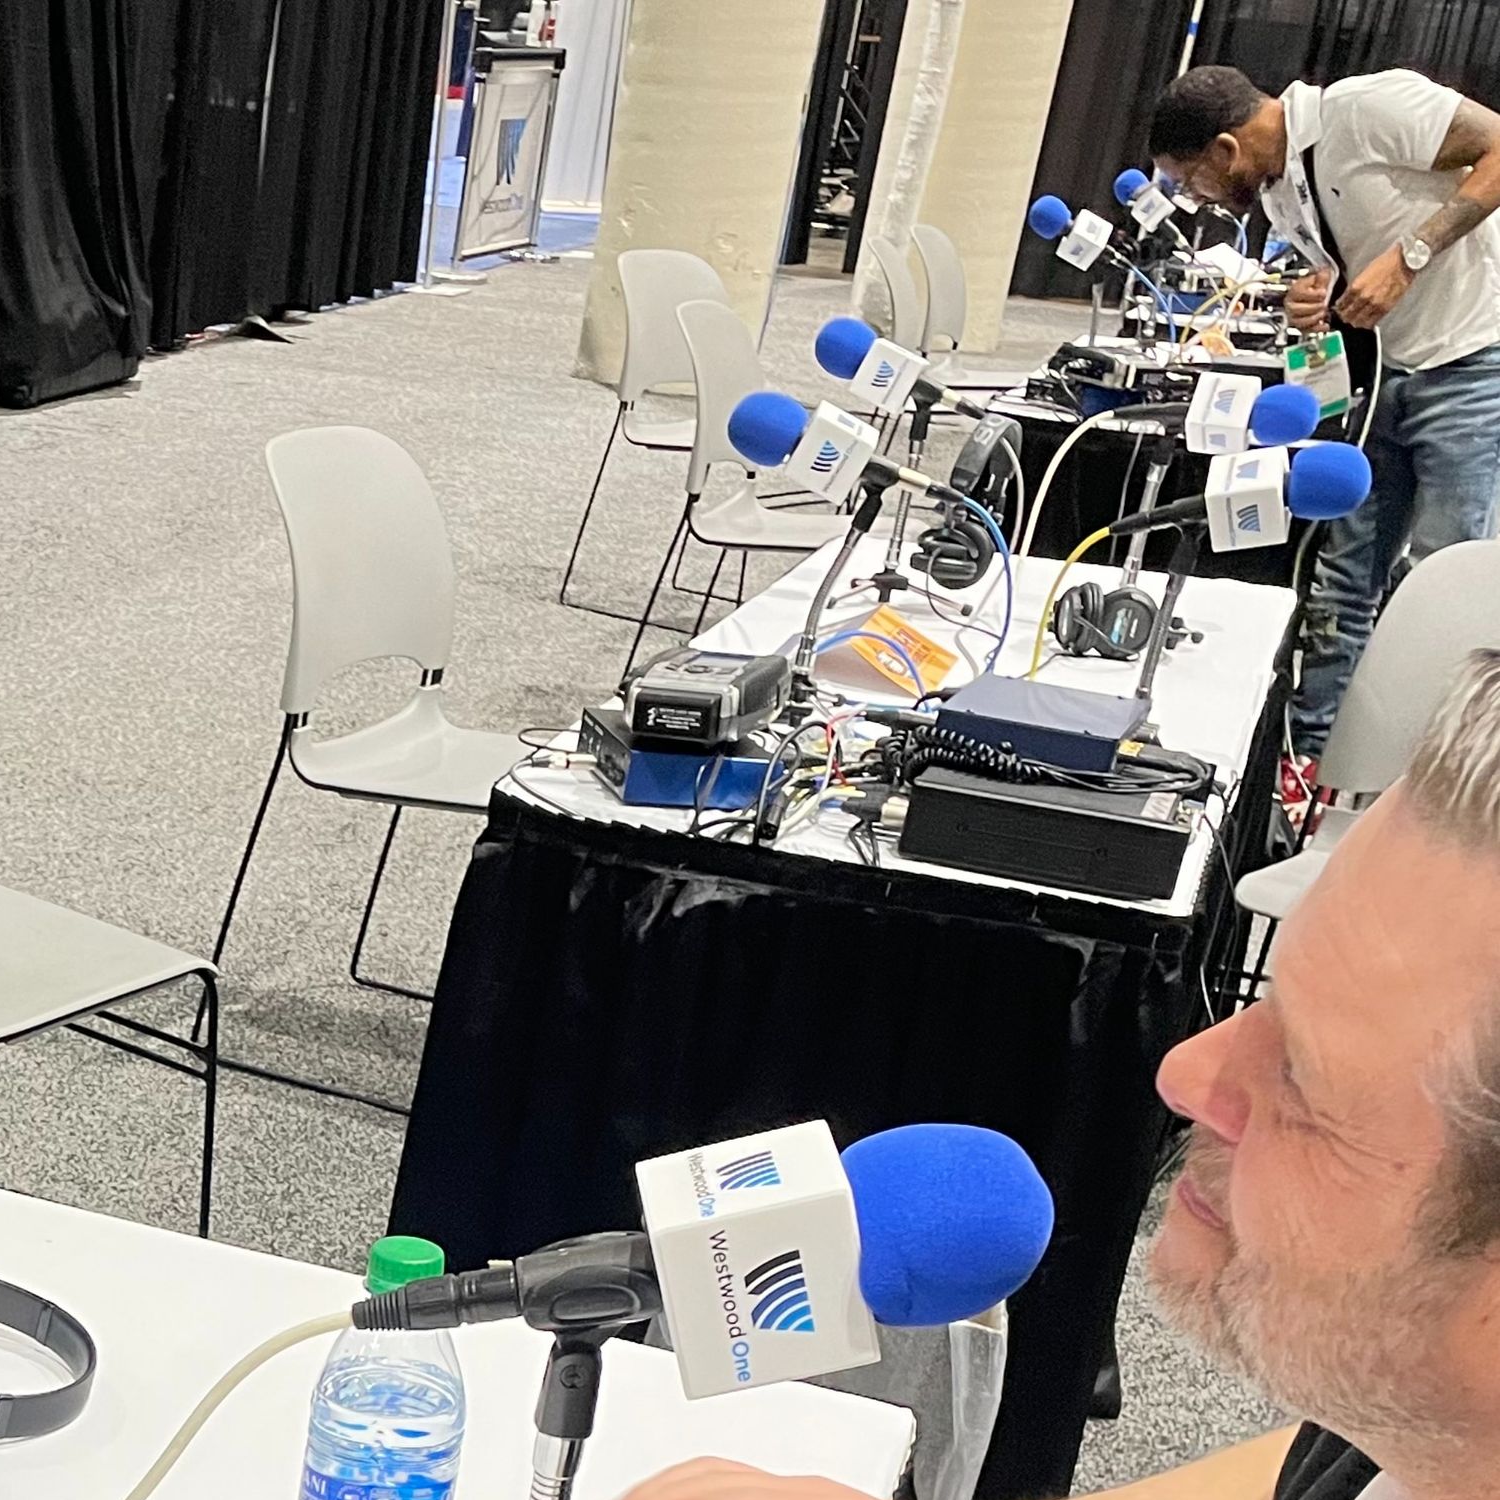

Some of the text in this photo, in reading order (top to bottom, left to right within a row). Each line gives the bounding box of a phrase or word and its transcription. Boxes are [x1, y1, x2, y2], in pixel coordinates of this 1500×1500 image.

[687, 1152, 714, 1218] Westwood One
[709, 1230, 751, 1382] Westwood One
